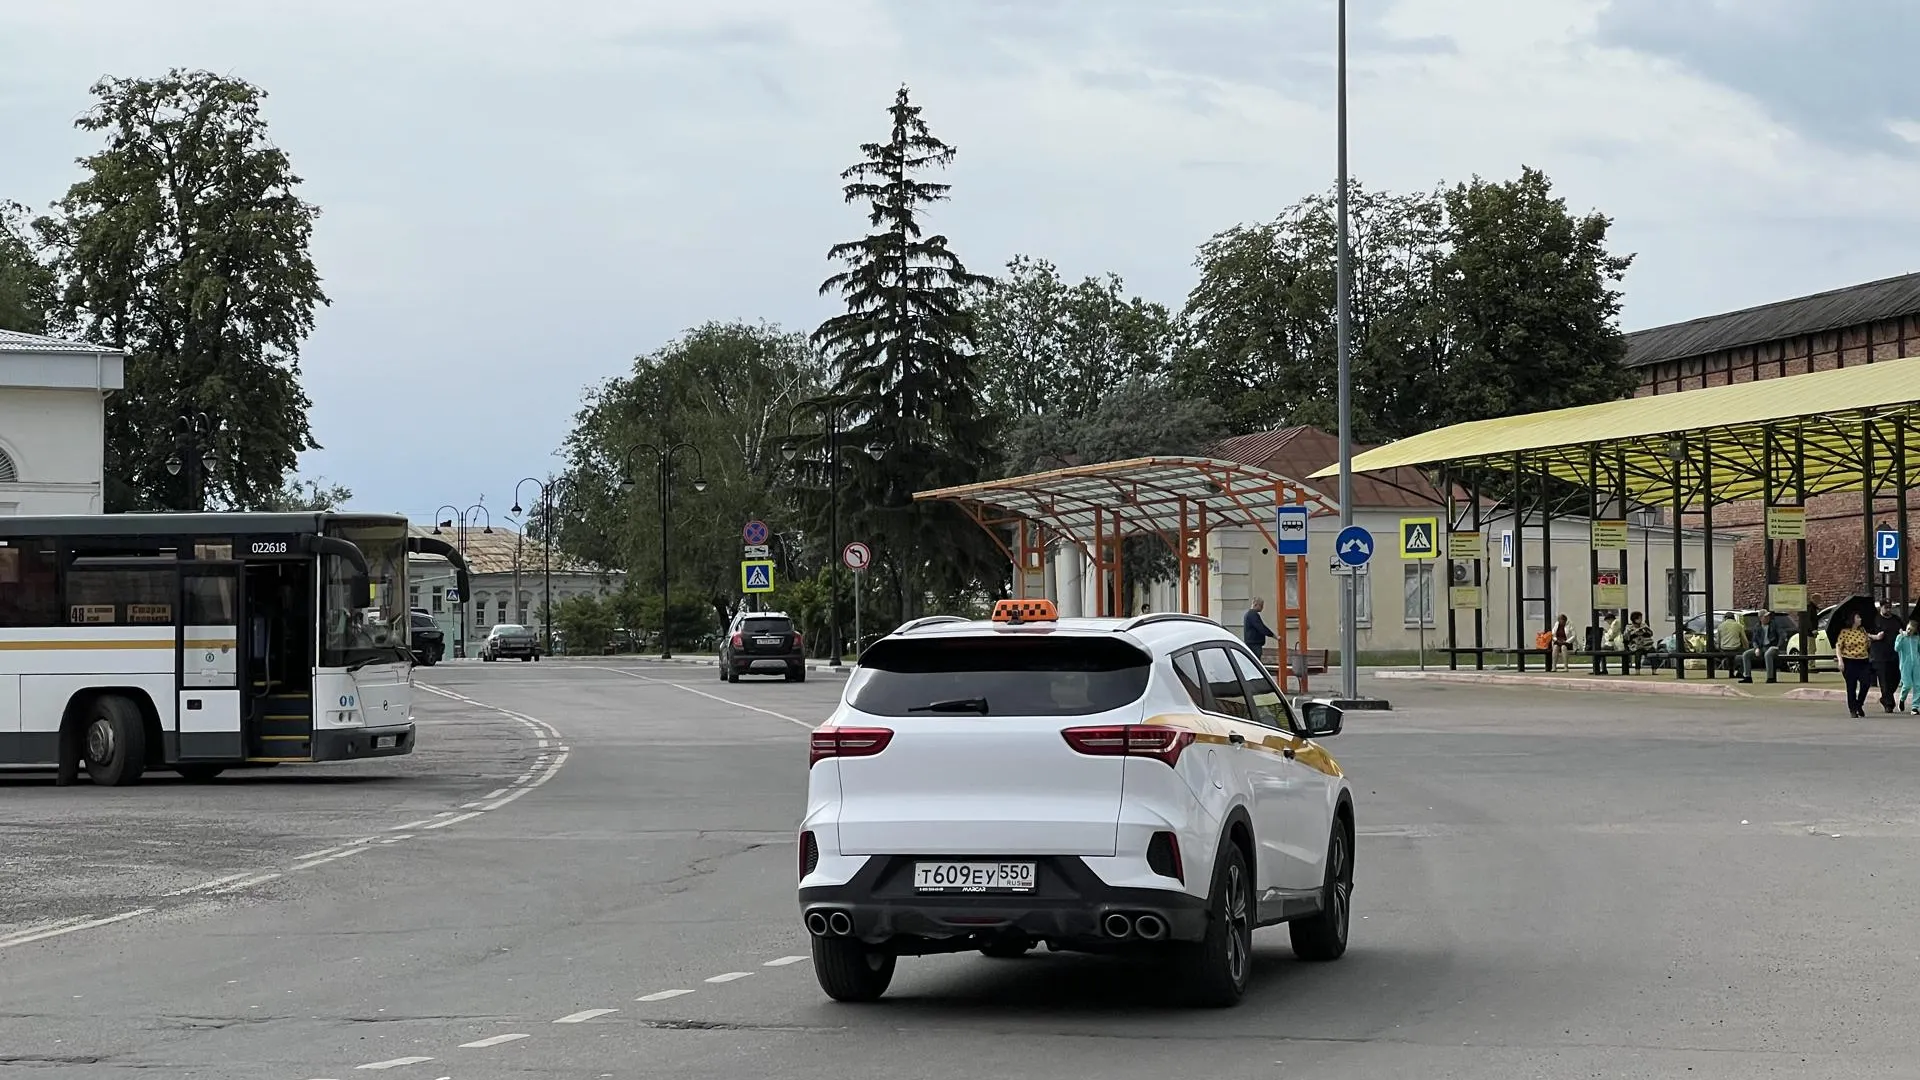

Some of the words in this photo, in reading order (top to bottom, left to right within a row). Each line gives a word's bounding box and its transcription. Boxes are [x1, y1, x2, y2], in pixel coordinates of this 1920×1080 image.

[251, 542, 287, 553] 022618
[1883, 534, 1896, 556] P
[72, 607, 85, 622] 48
[921, 865, 996, 885] Т609ЕУ
[999, 865, 1030, 880] 550
